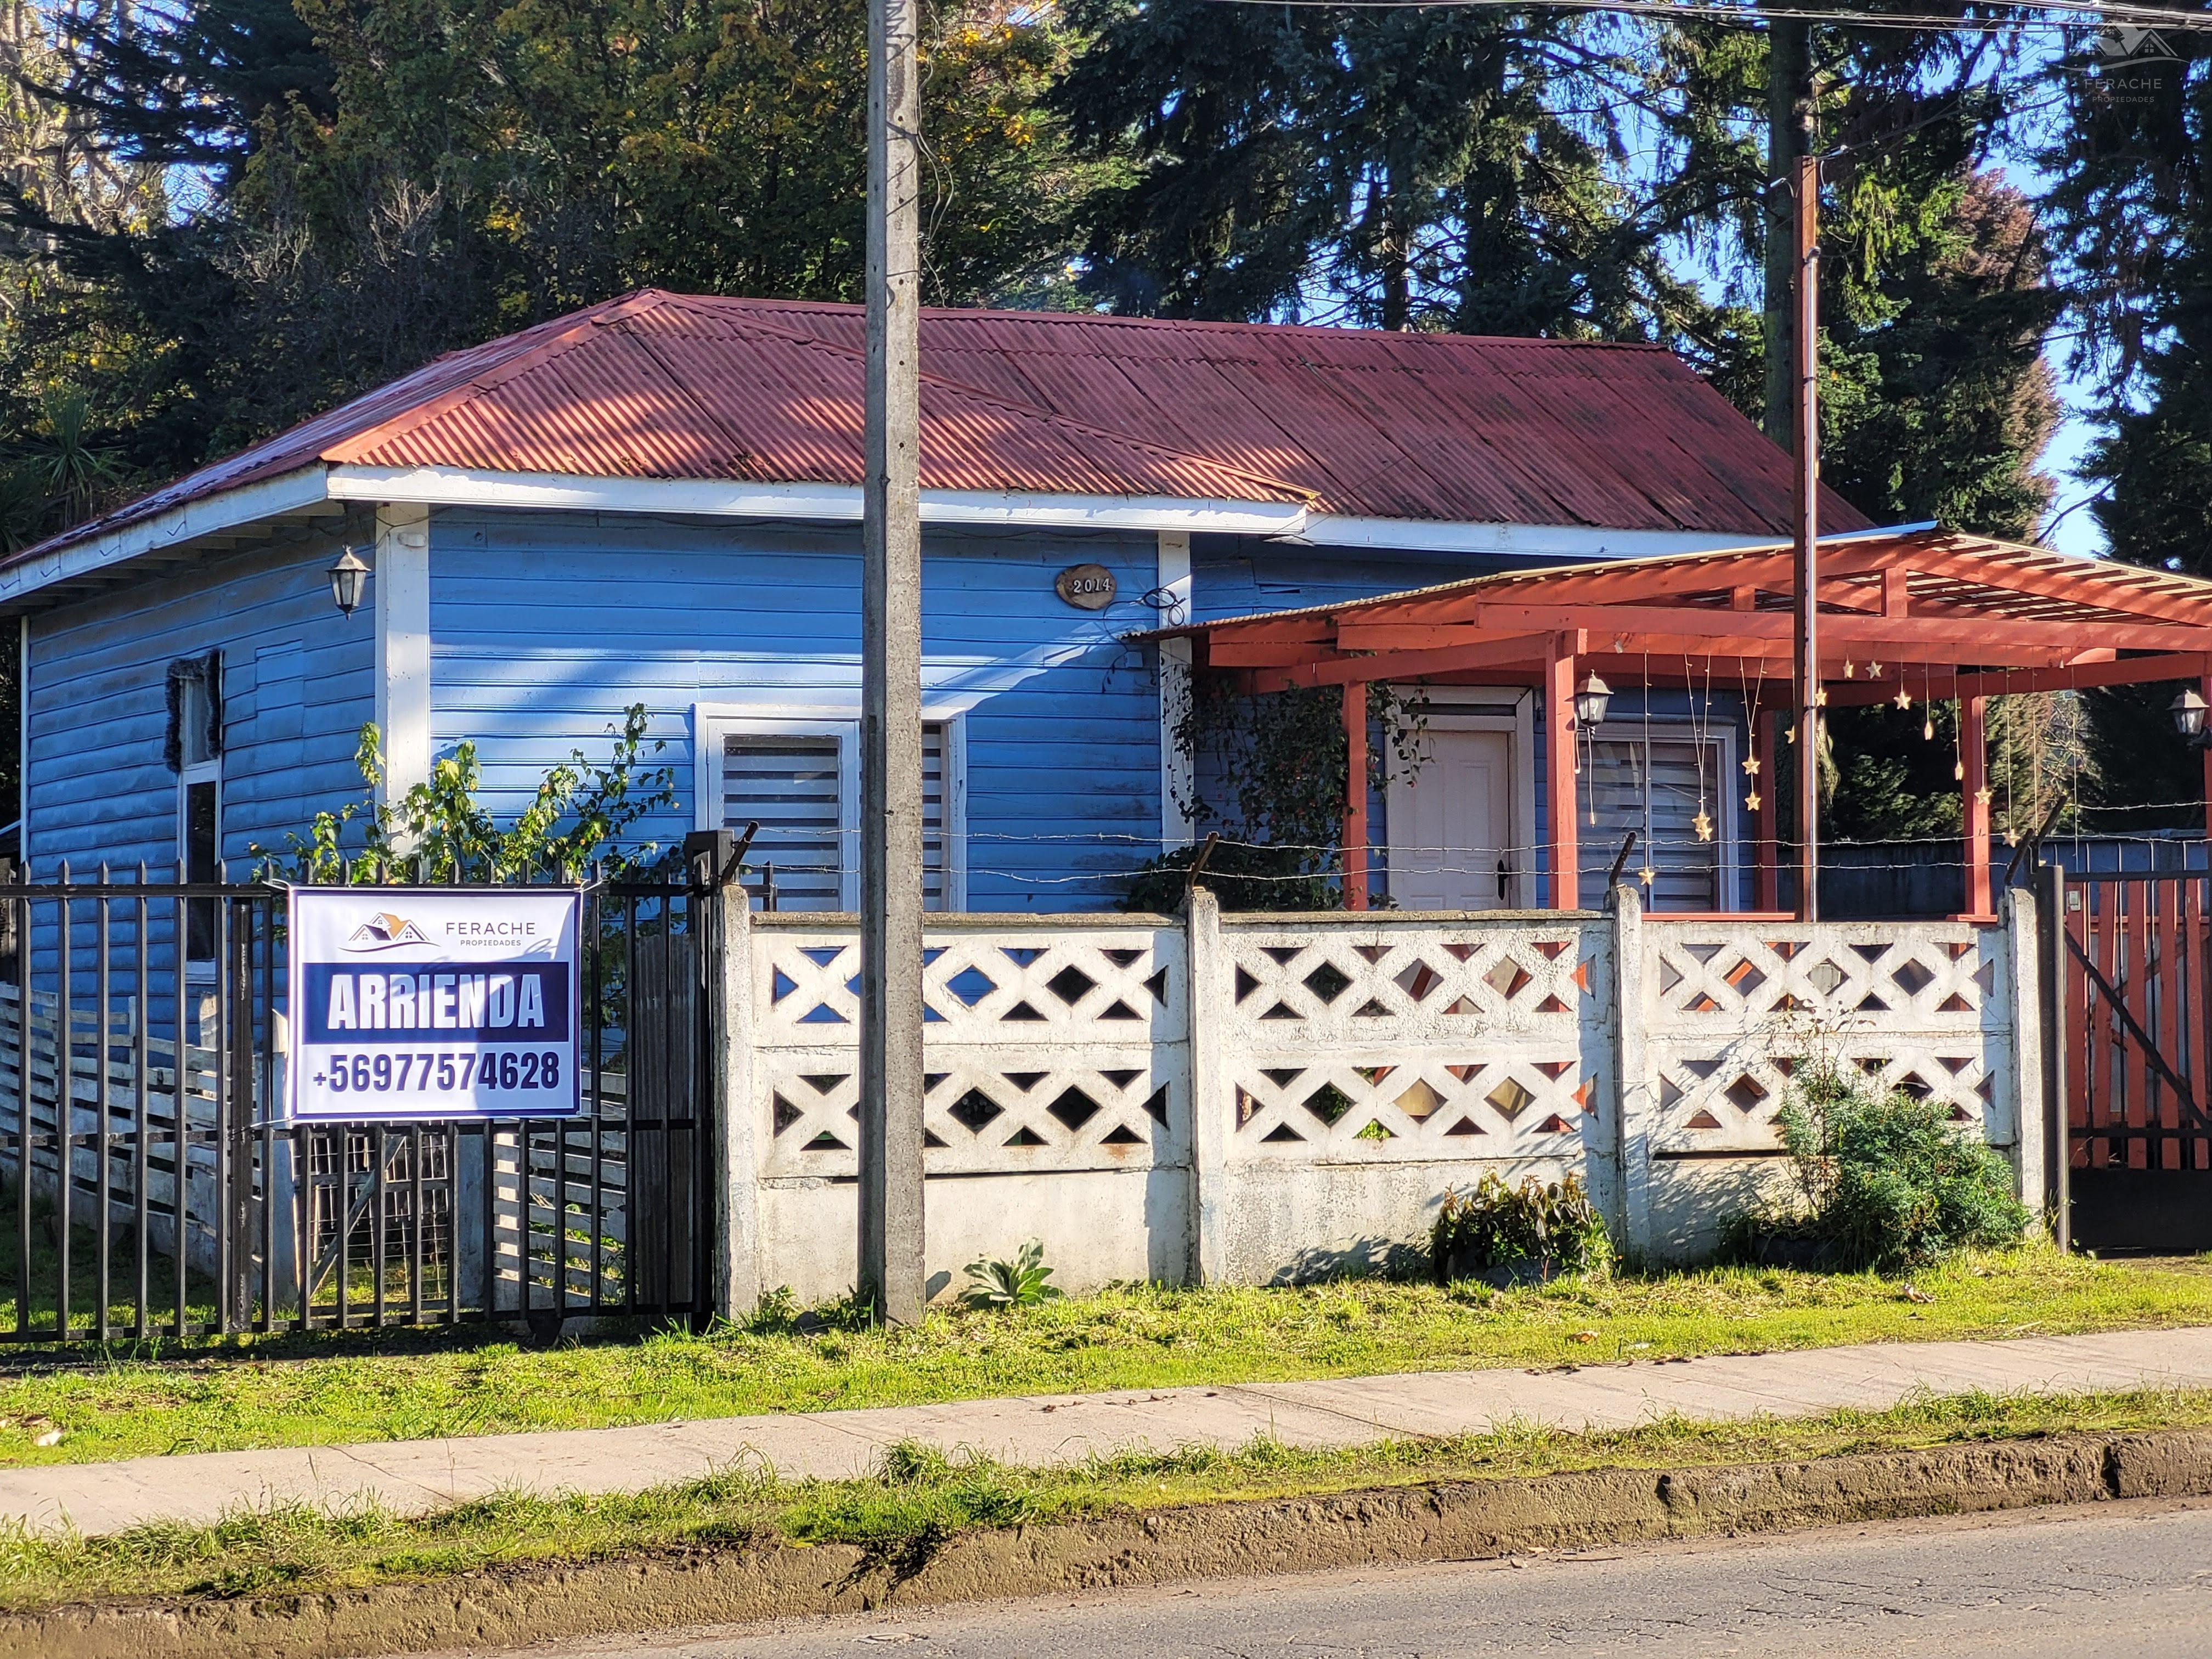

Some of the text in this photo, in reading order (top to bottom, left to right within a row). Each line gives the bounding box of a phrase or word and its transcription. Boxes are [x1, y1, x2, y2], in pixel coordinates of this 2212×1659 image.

[1074, 578, 1110, 592] 2014
[446, 922, 535, 935] FERACHE
[328, 974, 544, 1029] ARRIENDA
[313, 1052, 560, 1092] +56977574628
